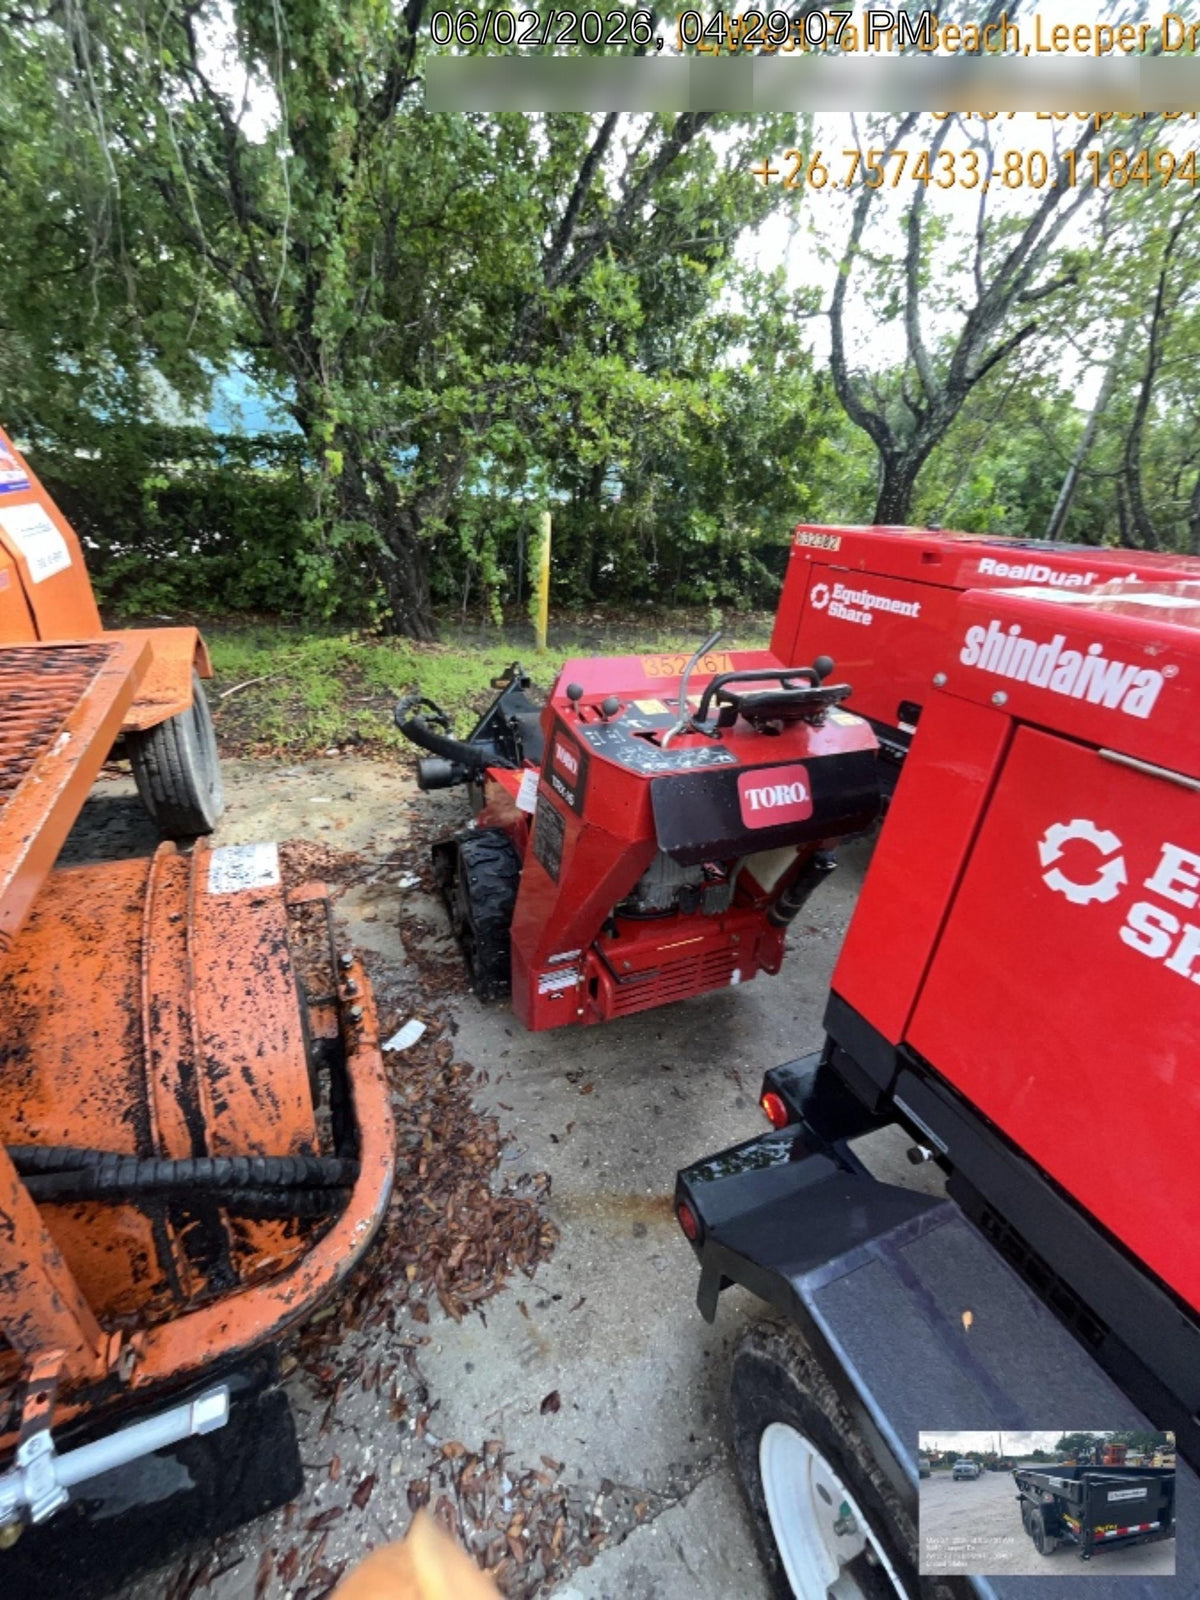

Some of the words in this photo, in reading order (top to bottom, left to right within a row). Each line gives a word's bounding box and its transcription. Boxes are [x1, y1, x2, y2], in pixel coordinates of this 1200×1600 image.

[978, 557, 1095, 586] RealDual
[828, 602, 873, 625] Share
[832, 583, 922, 618] Equipment
[960, 620, 1165, 719] shindaiwa
[556, 742, 578, 777] TORO
[744, 782, 806, 810] TORO
